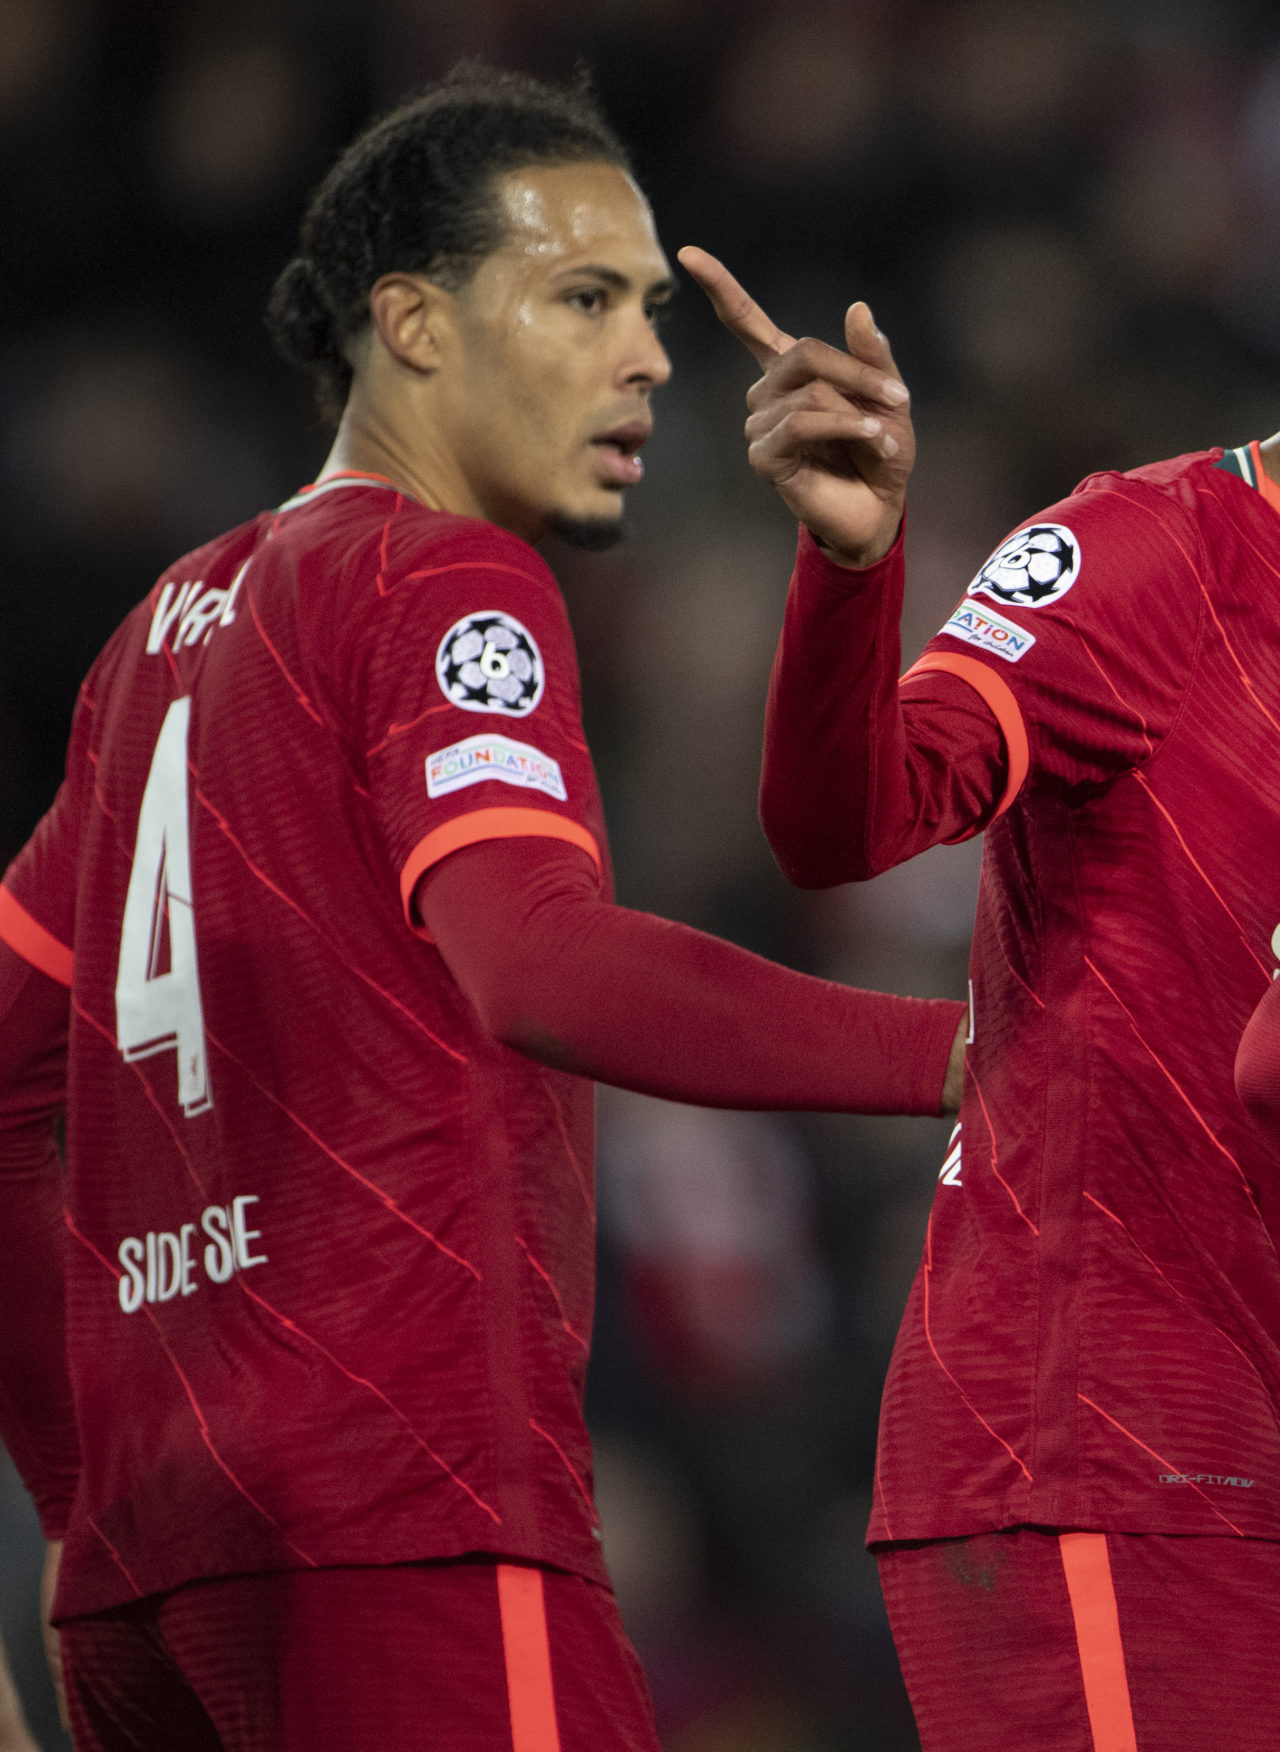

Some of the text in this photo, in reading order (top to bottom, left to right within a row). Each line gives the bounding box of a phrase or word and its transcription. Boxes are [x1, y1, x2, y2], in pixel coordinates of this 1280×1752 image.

[479, 641, 511, 681] 6
[115, 696, 213, 1118] 4
[118, 1223, 199, 1314] SIDE
